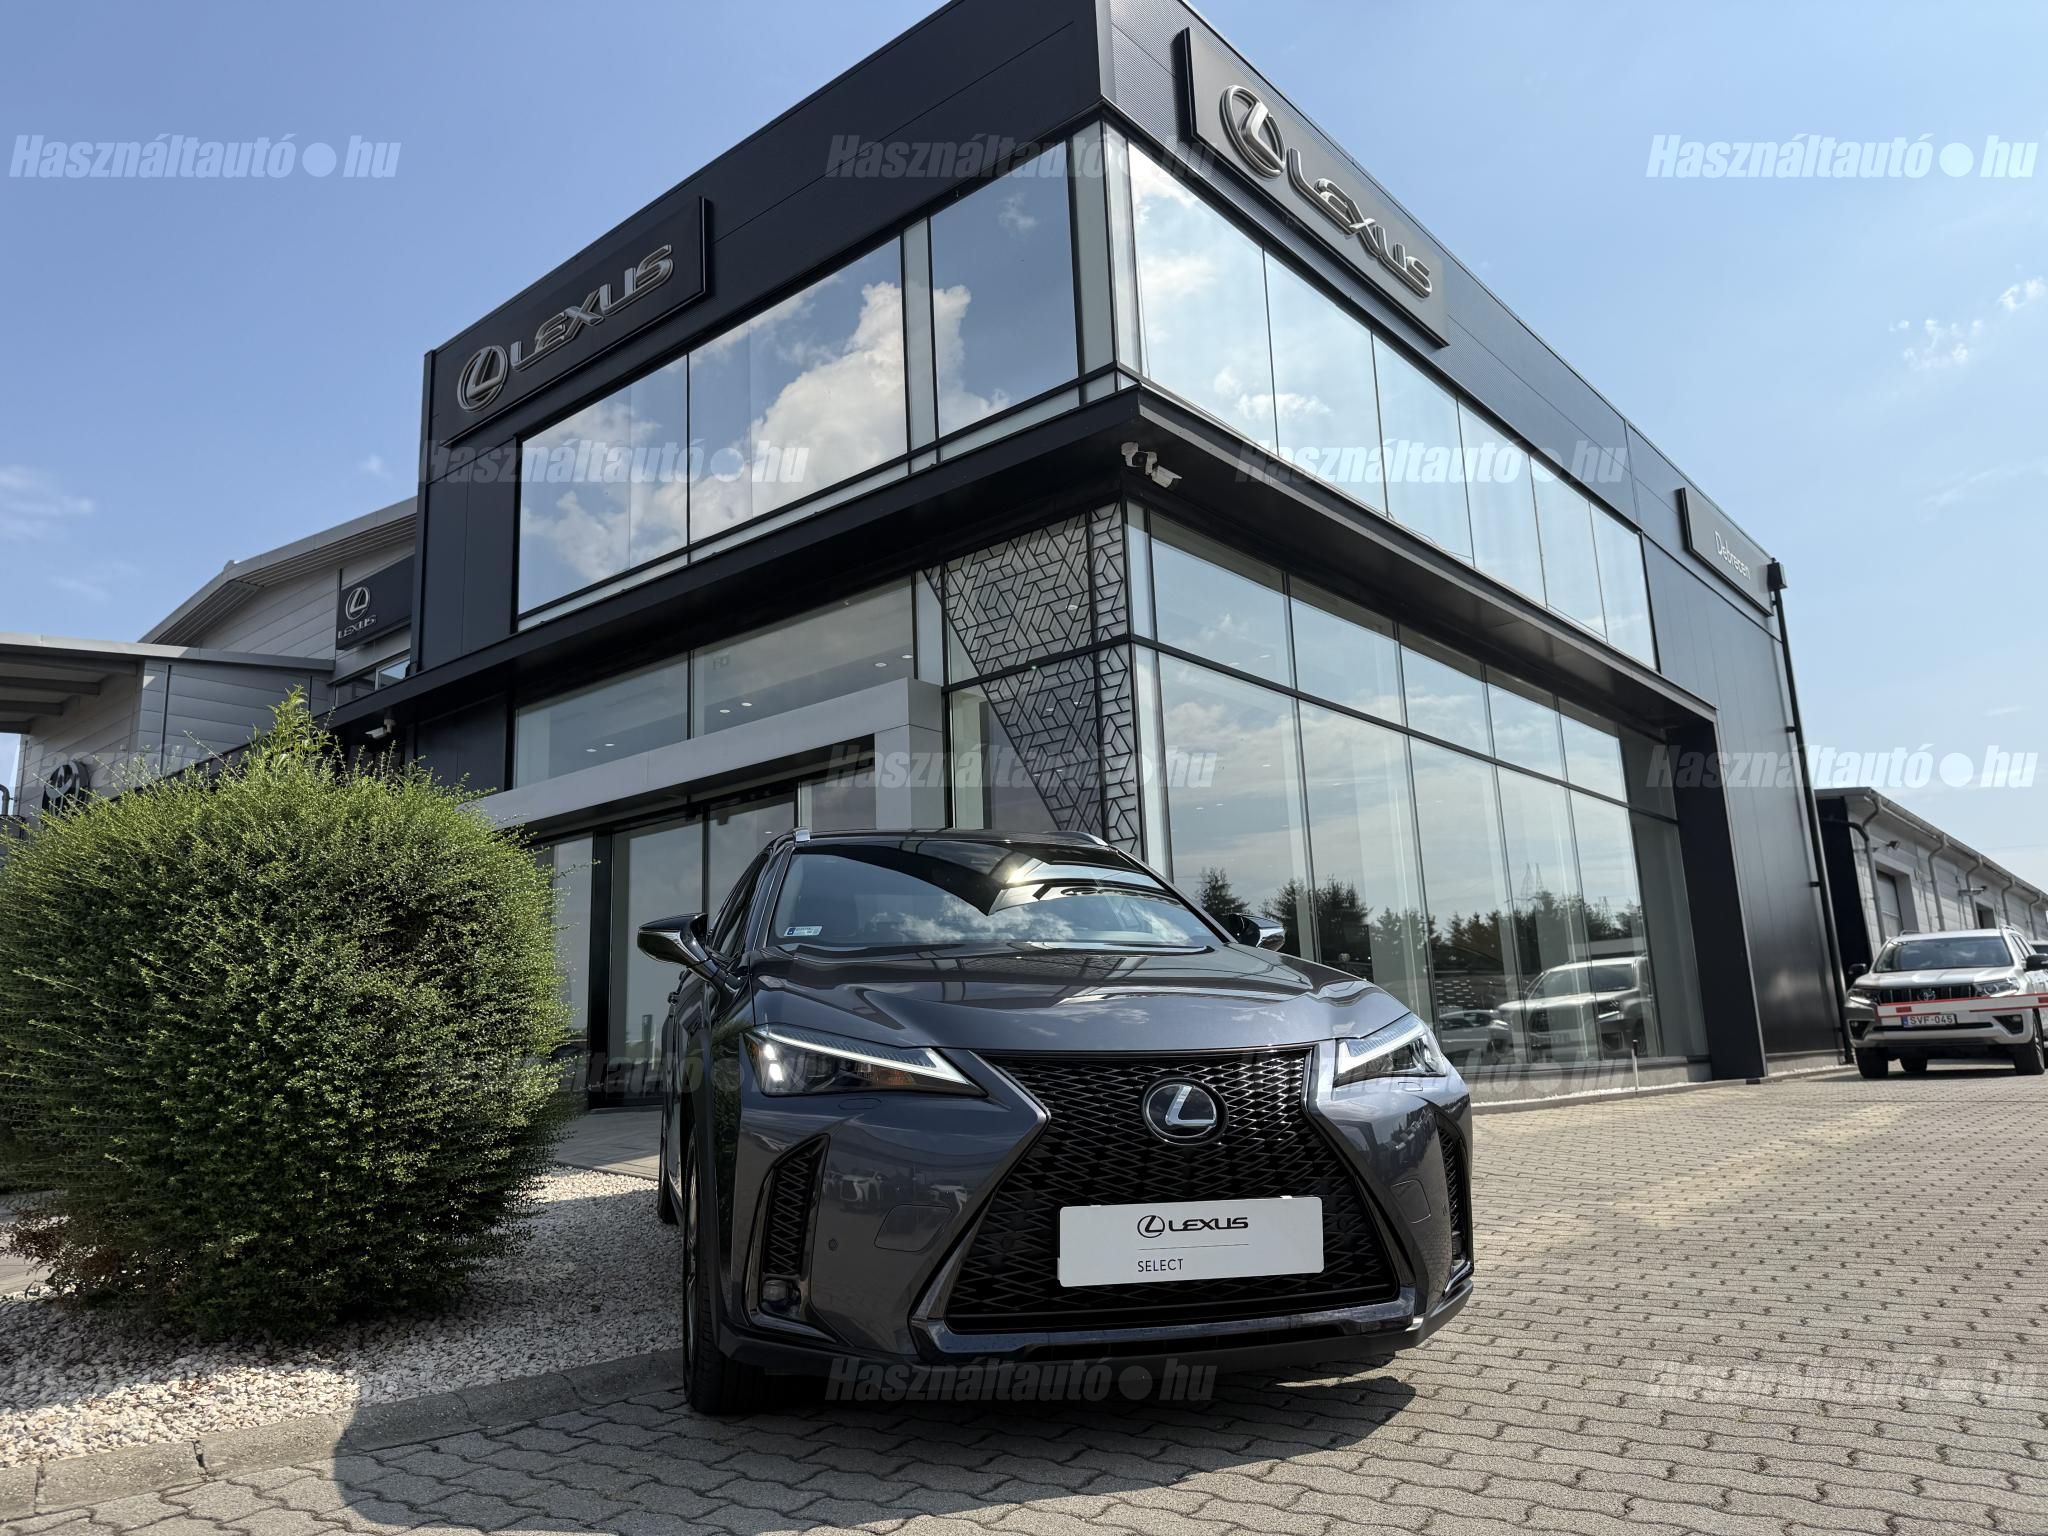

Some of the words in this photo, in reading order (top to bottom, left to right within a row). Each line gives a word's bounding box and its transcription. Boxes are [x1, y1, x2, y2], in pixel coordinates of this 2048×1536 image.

[1286, 147, 1433, 299] LEXUS
[510, 244, 674, 371] LEXUS
[1714, 529, 1751, 580] Debrecen
[338, 615, 377, 639] LEXUS
[1910, 1015, 1953, 1025] SVF-045
[1168, 1216, 1249, 1231] LEXUS
[1137, 1258, 1183, 1272] SELECT
